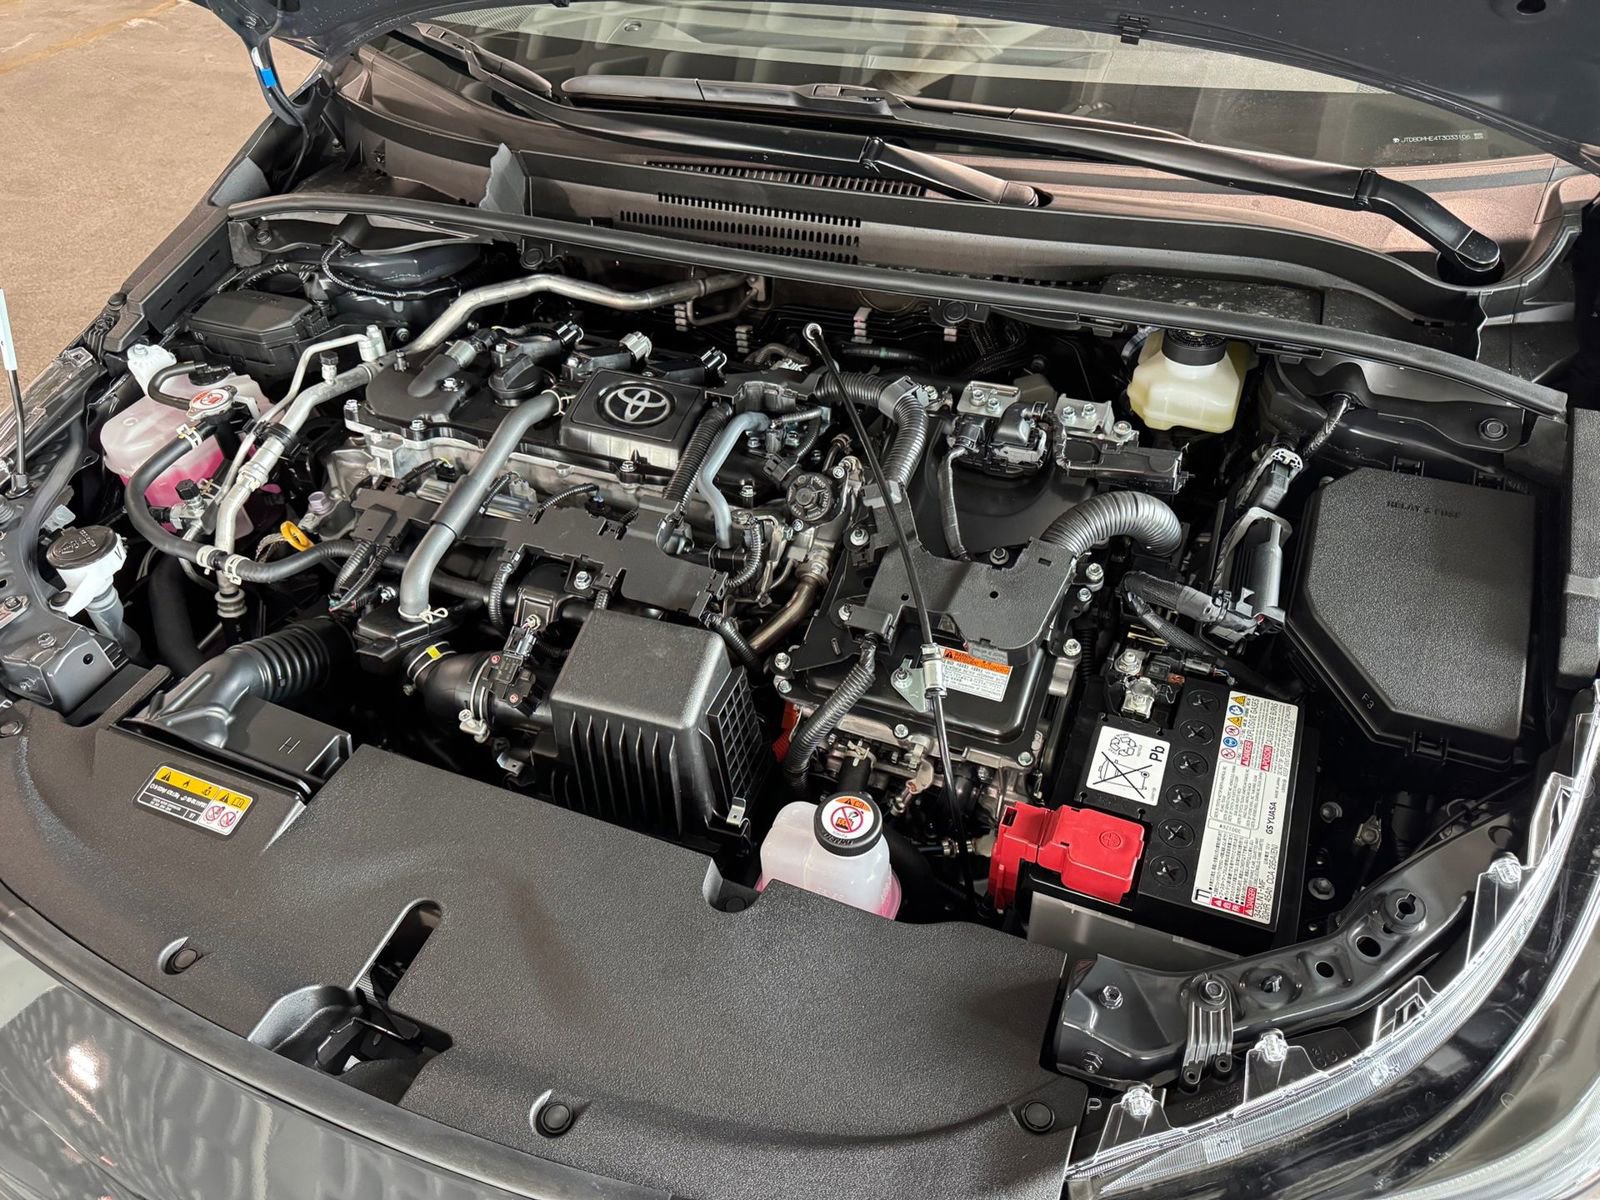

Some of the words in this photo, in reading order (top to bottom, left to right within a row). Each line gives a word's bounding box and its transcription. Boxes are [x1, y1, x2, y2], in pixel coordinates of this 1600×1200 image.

[1386, 501, 1420, 512] RELAY
[1249, 697, 1259, 714] GASES
[1361, 691, 1375, 710] F3
[1245, 713, 1257, 740] EXPLOSIVE
[1149, 745, 1165, 762] Pb
[1267, 802, 1276, 825] YUASA
[1265, 824, 1273, 834] GS
[1266, 870, 1275, 884] CCA
[1245, 886, 1256, 909] DANGER
[1086, 1097, 1103, 1115] P
